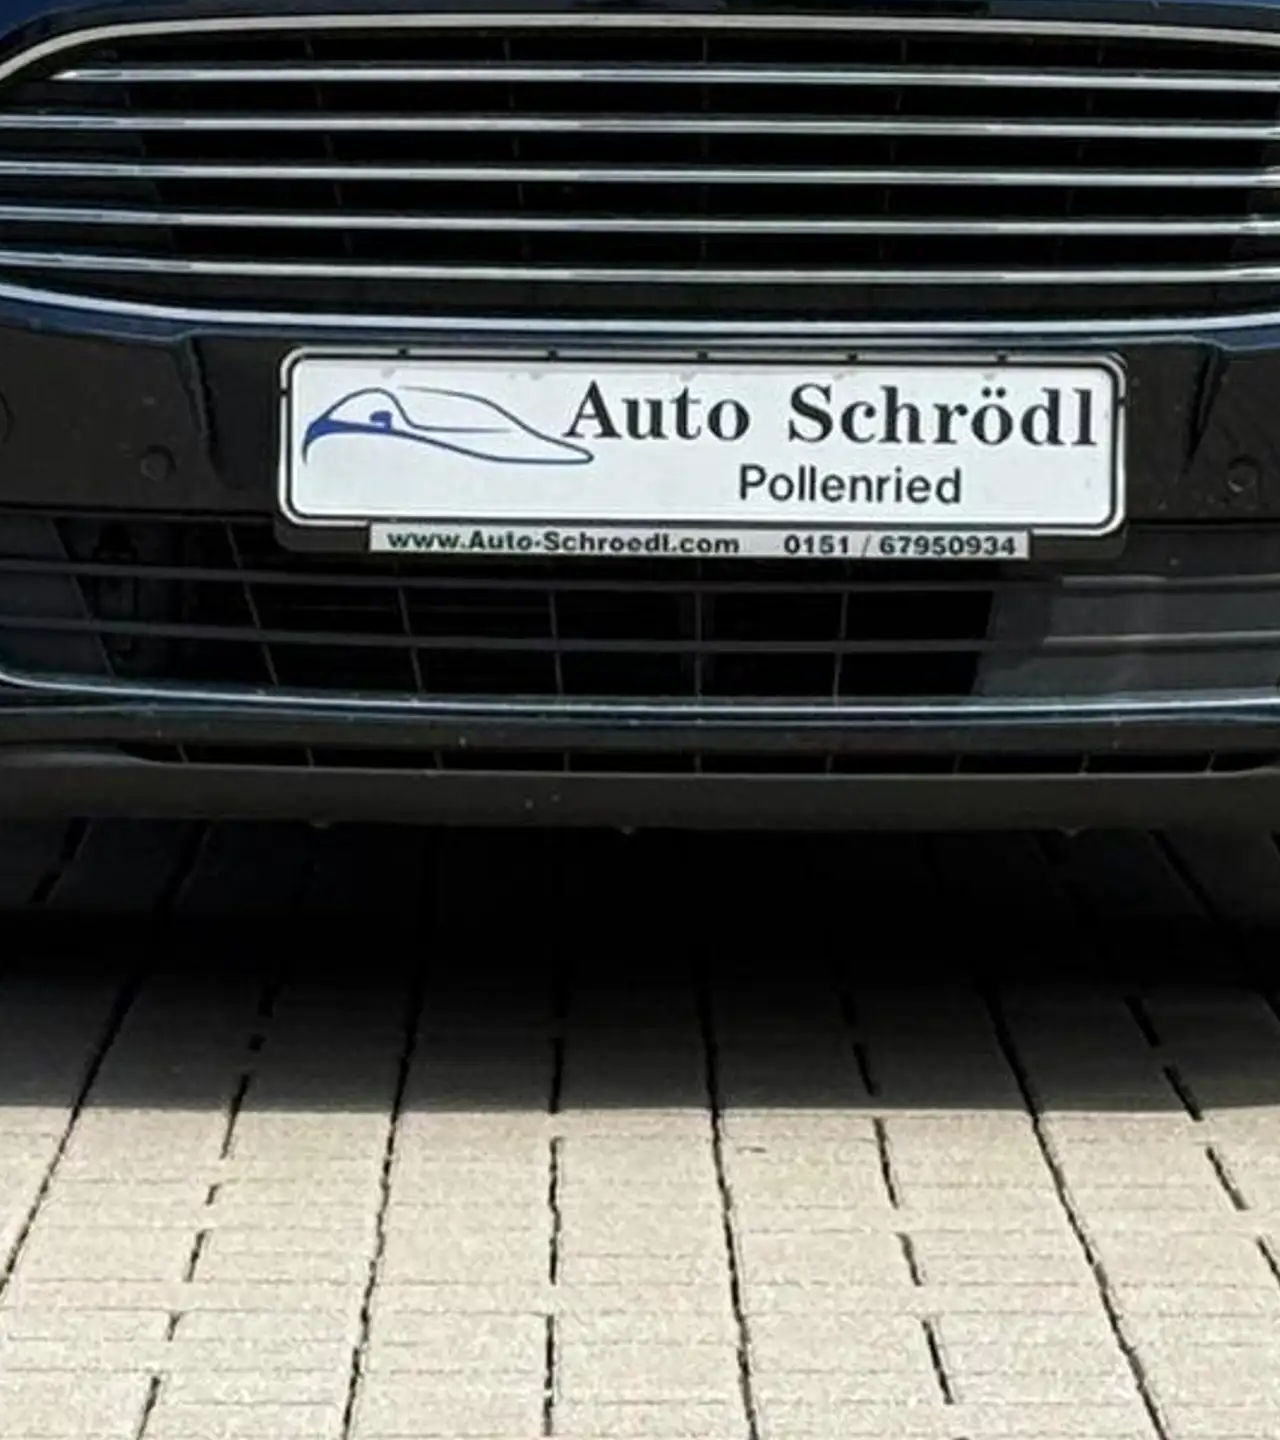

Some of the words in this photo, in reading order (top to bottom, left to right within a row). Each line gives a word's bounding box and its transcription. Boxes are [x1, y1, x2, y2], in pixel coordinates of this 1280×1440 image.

[561, 379, 751, 442] Auto
[787, 382, 1100, 449] Schrödl
[737, 463, 963, 507] Pollenried
[385, 529, 741, 556] www.Auto-Schroedl.com
[783, 532, 849, 557] 0151
[878, 533, 1018, 558] 67950934
